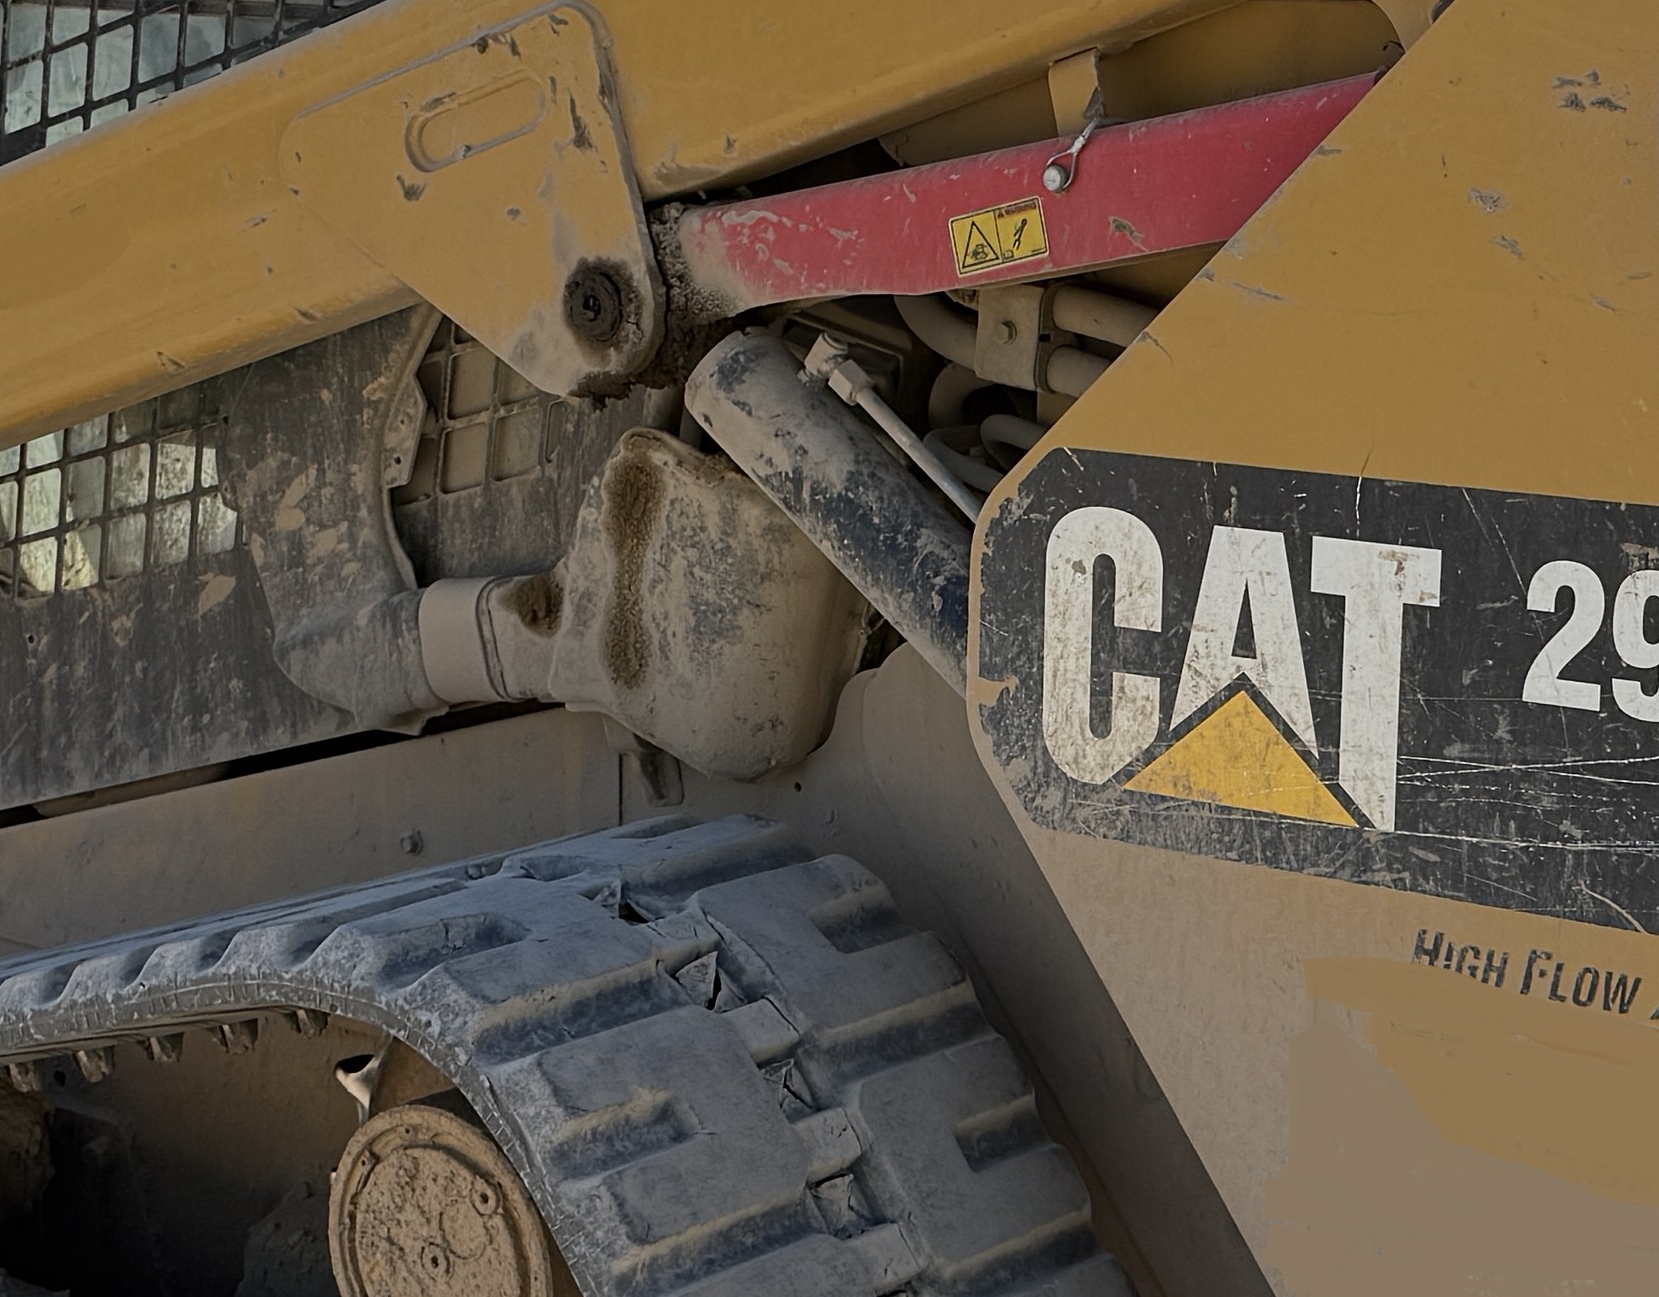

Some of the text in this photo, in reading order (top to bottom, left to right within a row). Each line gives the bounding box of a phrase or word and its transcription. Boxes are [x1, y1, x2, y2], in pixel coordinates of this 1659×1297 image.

[1041, 506, 1442, 833] CAT
[1411, 928, 1509, 988] HIGH
[1519, 949, 1643, 1015] FLOW
